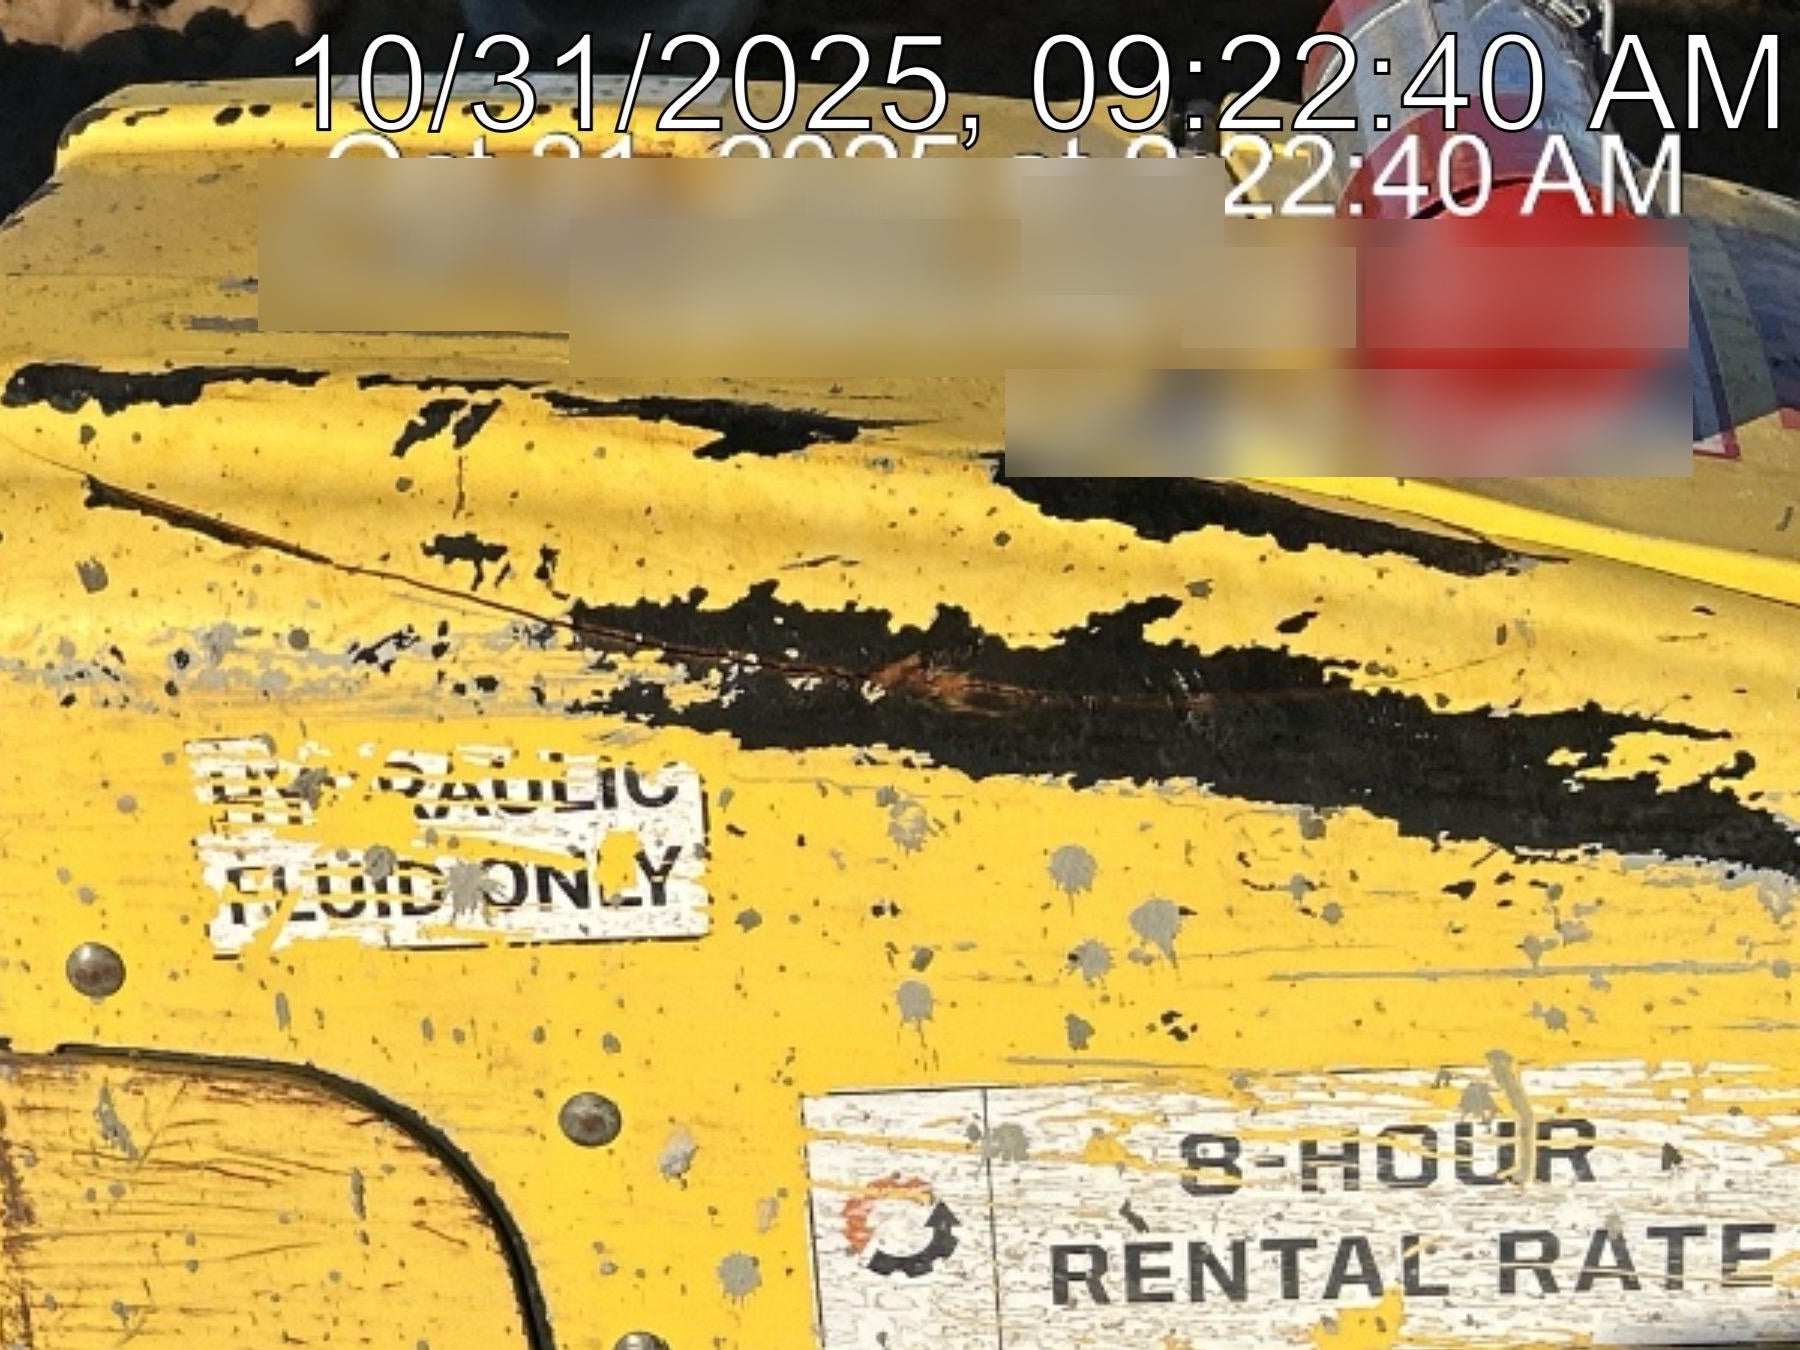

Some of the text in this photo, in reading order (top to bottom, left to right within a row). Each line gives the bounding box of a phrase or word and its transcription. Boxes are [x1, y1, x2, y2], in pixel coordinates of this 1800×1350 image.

[1178, 1117, 1597, 1197] 8-HOUR
[1050, 1223, 1777, 1306] RENTAL RATE
